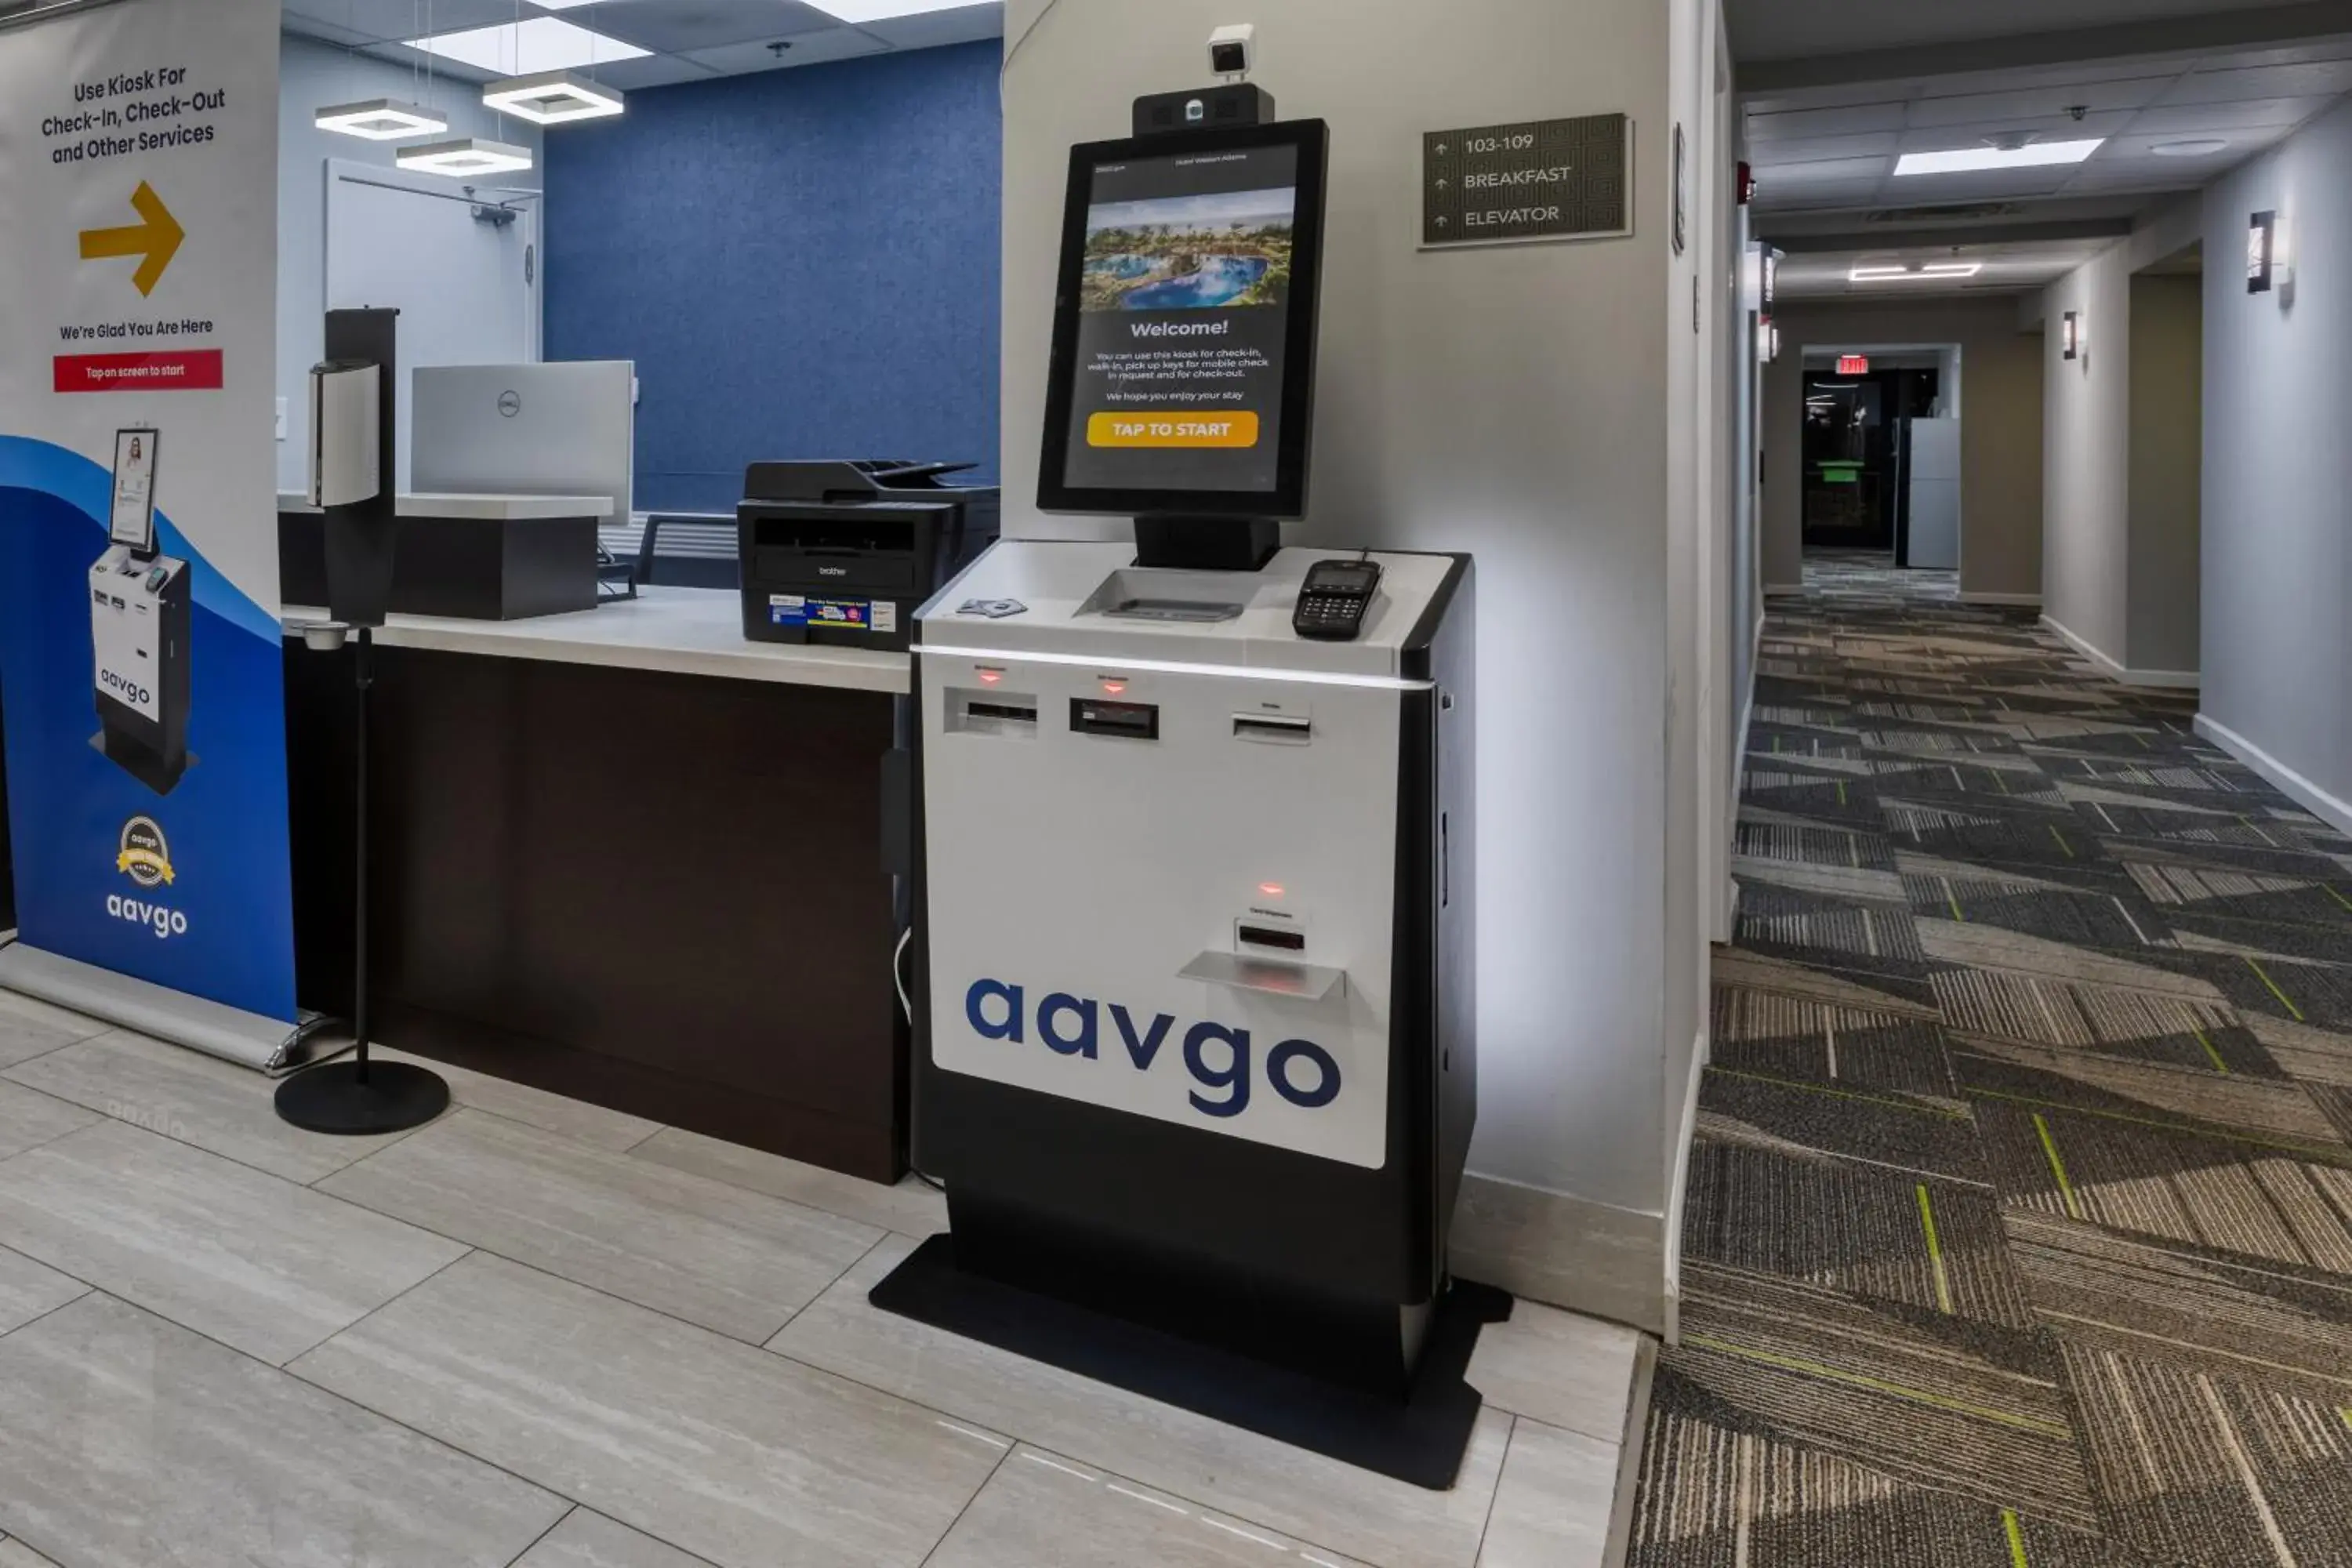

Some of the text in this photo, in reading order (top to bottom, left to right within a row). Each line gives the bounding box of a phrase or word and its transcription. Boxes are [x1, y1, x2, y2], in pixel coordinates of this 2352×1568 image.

[74, 67, 186, 102] Use Kiosk For
[42, 88, 225, 136] Check-In, Check-Out
[53, 124, 214, 163] and Other Services
[1465, 134, 1534, 154] 103-109
[1465, 165, 1571, 189] BREAKFAST
[1465, 206, 1559, 226] ELEVATOR
[60, 319, 213, 339] We're Glad You Are Here
[1131, 320, 1229, 337] Welcome!
[1125, 361, 1145, 371] pick
[1163, 361, 1184, 371] keys
[1201, 358, 1236, 368] mobile
[1238, 358, 1269, 367] check
[1134, 351, 1152, 360] use
[1153, 350, 1171, 359] this
[1173, 350, 1199, 358] kiosk
[1200, 349, 1214, 358] for
[85, 365, 185, 382] Tap on screen to start
[1119, 371, 1154, 380] request
[1177, 370, 1191, 379] for
[1106, 392, 1123, 401] We
[1123, 392, 1148, 402] hope
[1149, 393, 1167, 402] you
[1169, 392, 1196, 402] enjoy
[1198, 392, 1221, 402] your
[1112, 423, 1232, 437] TAP TO START
[101, 668, 150, 704] aavgo
[106, 894, 187, 938] aavgo
[965, 978, 1341, 1118] aavgo
